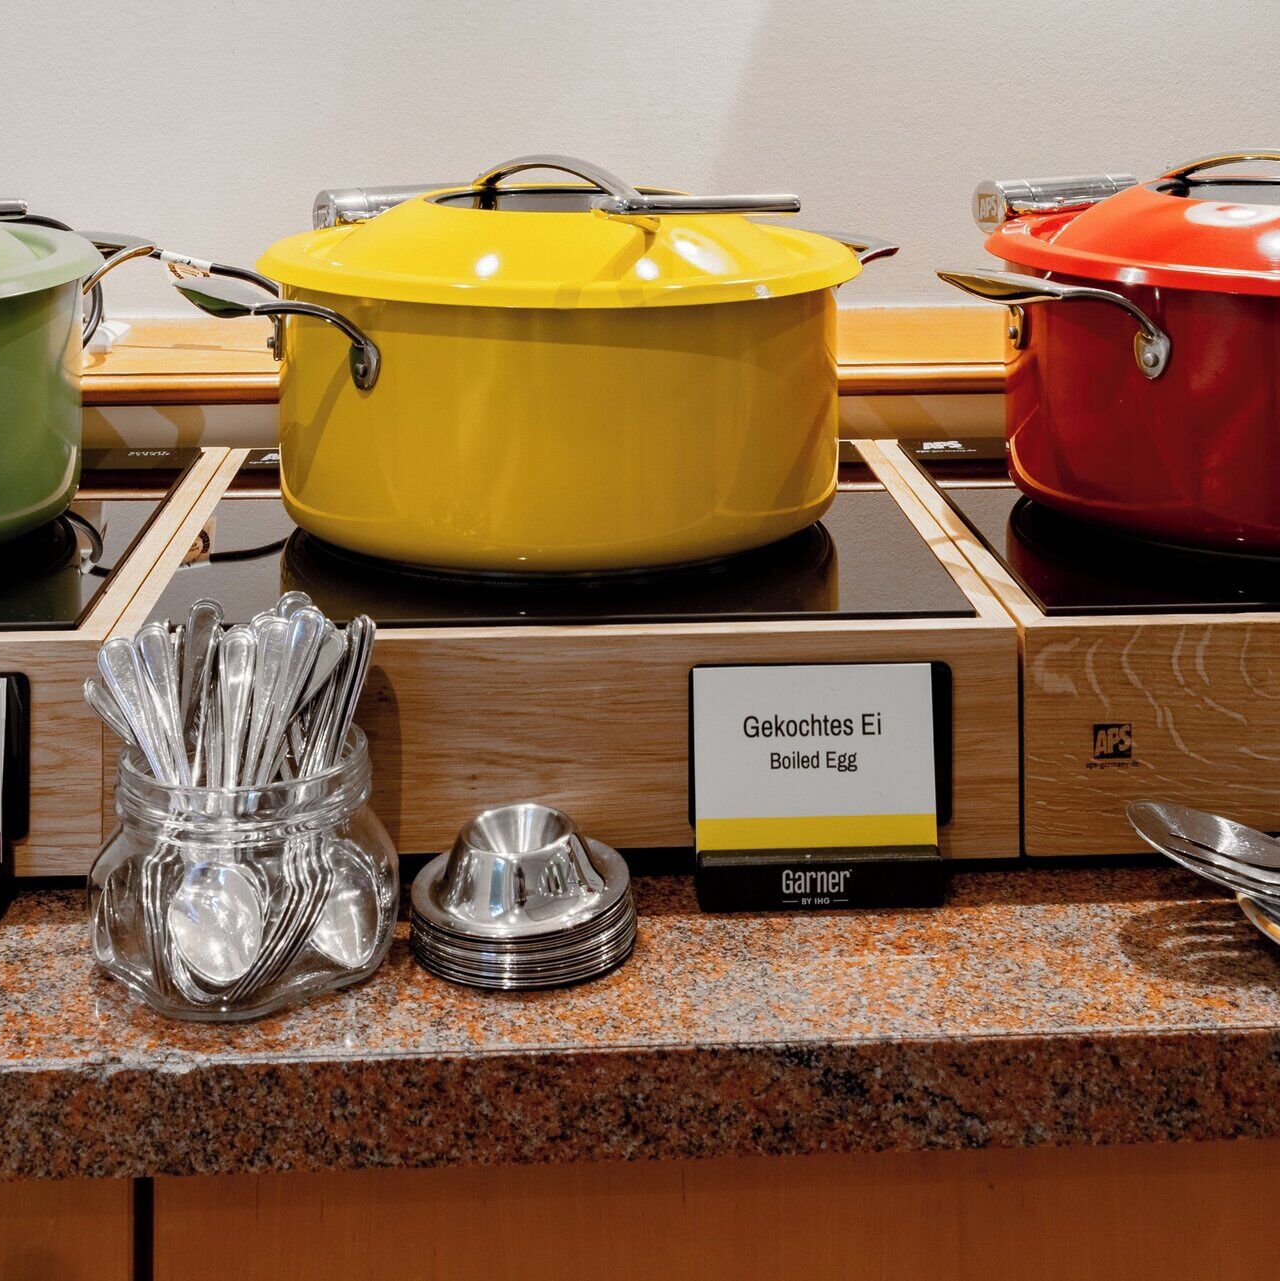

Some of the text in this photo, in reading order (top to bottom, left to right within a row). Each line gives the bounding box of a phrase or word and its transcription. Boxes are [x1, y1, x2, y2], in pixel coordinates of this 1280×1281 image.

[743, 712, 882, 738] Gekochtes Ei
[1094, 725, 1131, 757] APS
[770, 751, 858, 772] Boiled Egg
[782, 869, 851, 894] Garner
[814, 897, 830, 905] IHG
